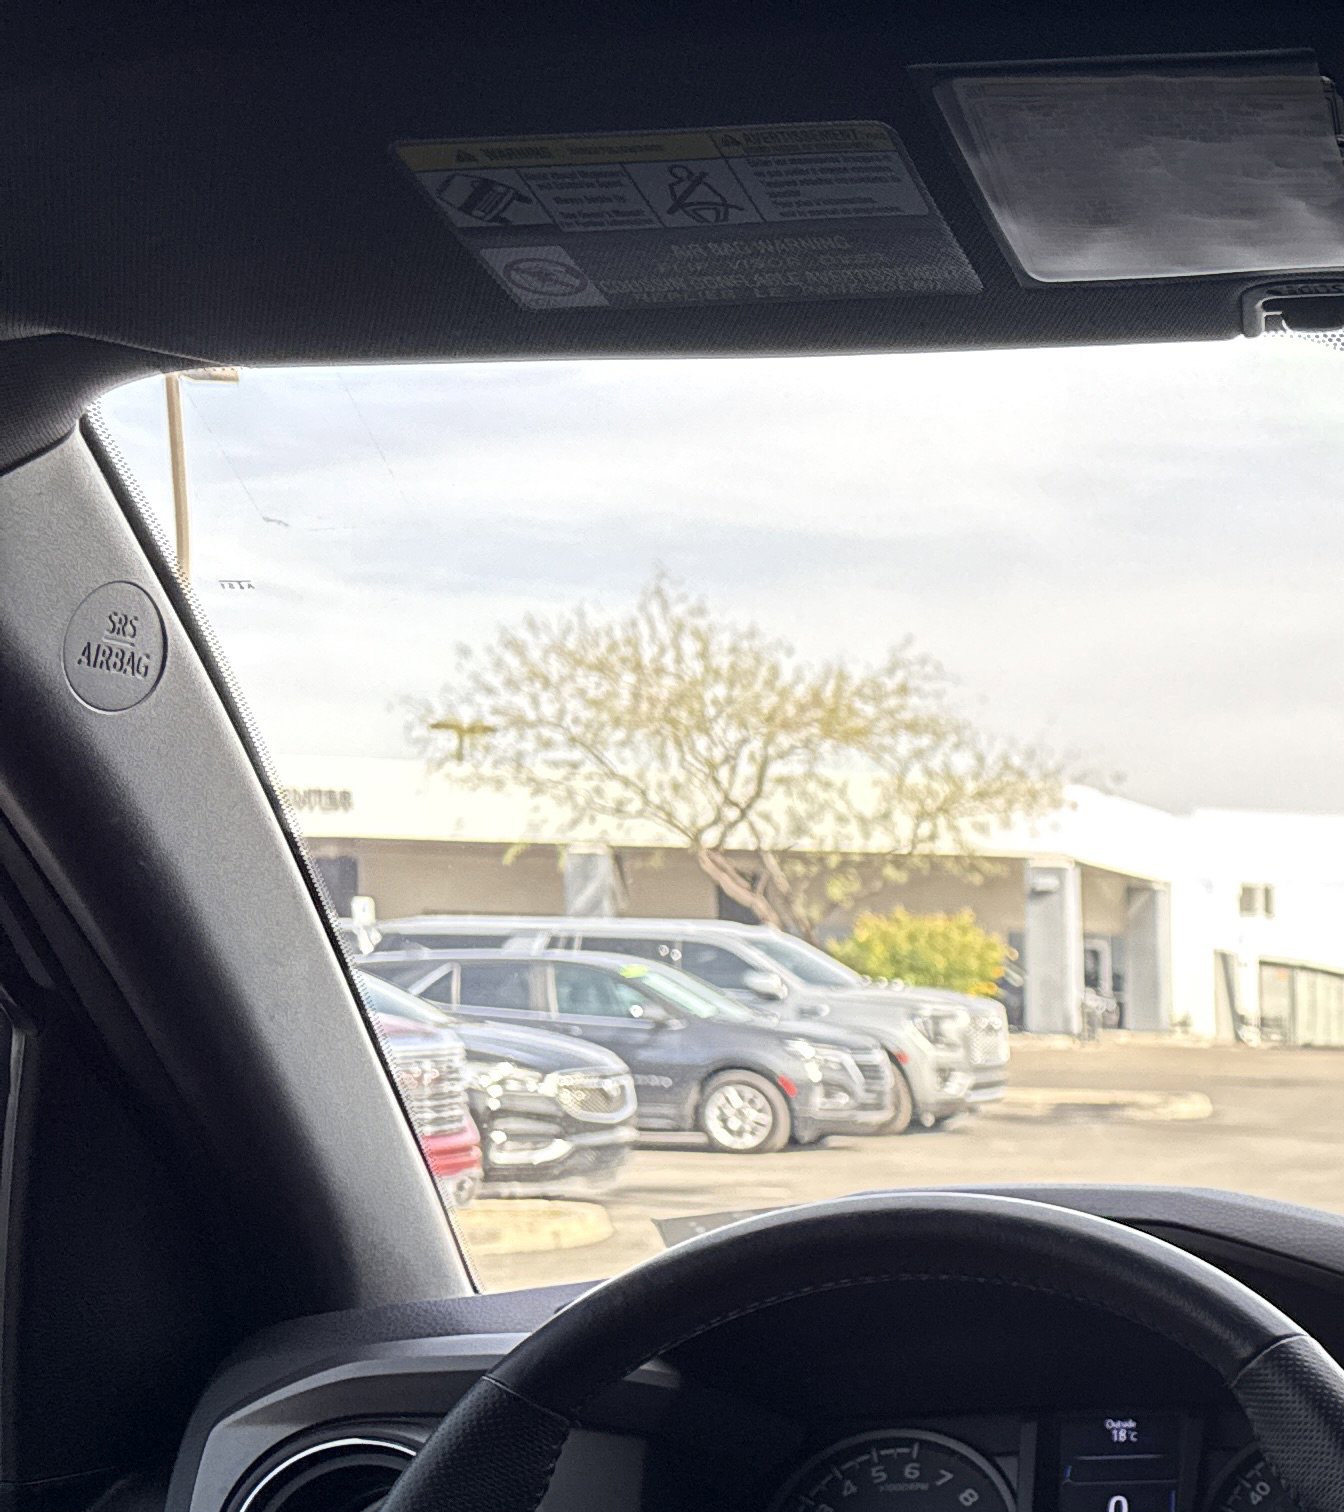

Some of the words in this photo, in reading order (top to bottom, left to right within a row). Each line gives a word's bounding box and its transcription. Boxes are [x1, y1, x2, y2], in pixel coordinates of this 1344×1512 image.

[106, 611, 139, 638] SRS
[77, 641, 151, 679] AIRBAG
[871, 1465, 888, 1483] 5
[904, 1462, 921, 1480] 6
[936, 1469, 954, 1487] 7
[959, 1488, 980, 1507] 8
[1250, 1481, 1271, 1506] 40
